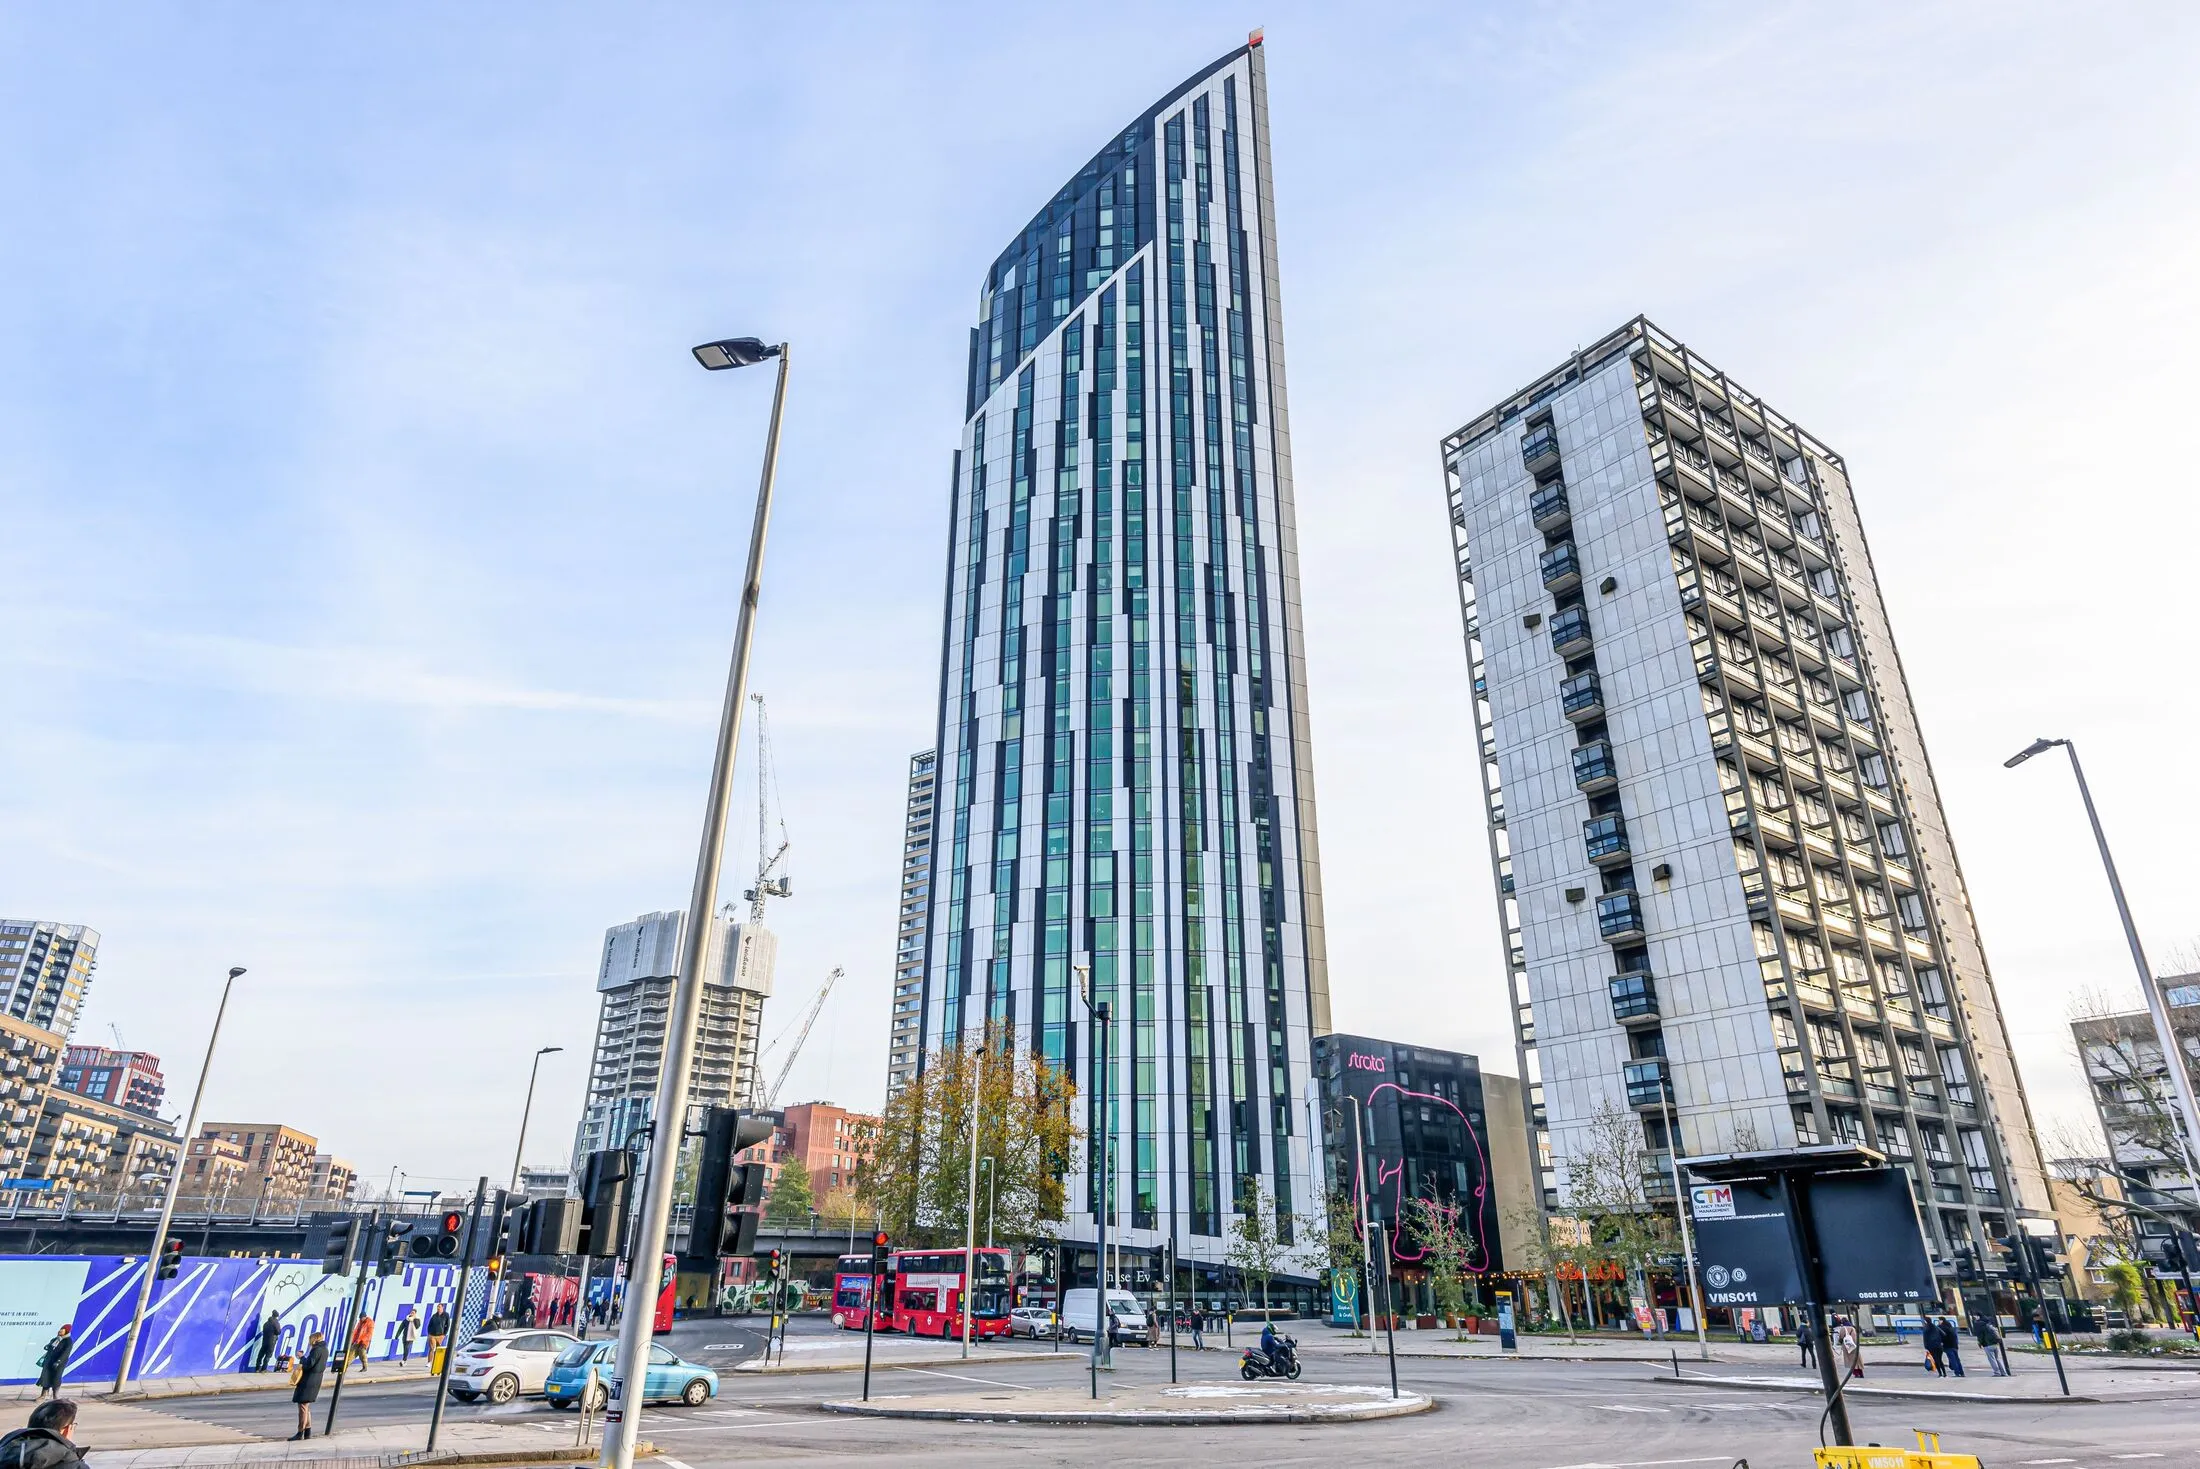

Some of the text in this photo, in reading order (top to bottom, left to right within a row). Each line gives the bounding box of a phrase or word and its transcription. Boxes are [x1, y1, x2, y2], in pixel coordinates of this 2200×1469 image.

[741, 946, 750, 977] lendlease
[1348, 1051, 1386, 1073] strata
[1693, 1188, 1732, 1204] CTM
[1096, 1270, 1170, 1283] hse Evs
[274, 1277, 386, 1360] CONNC
